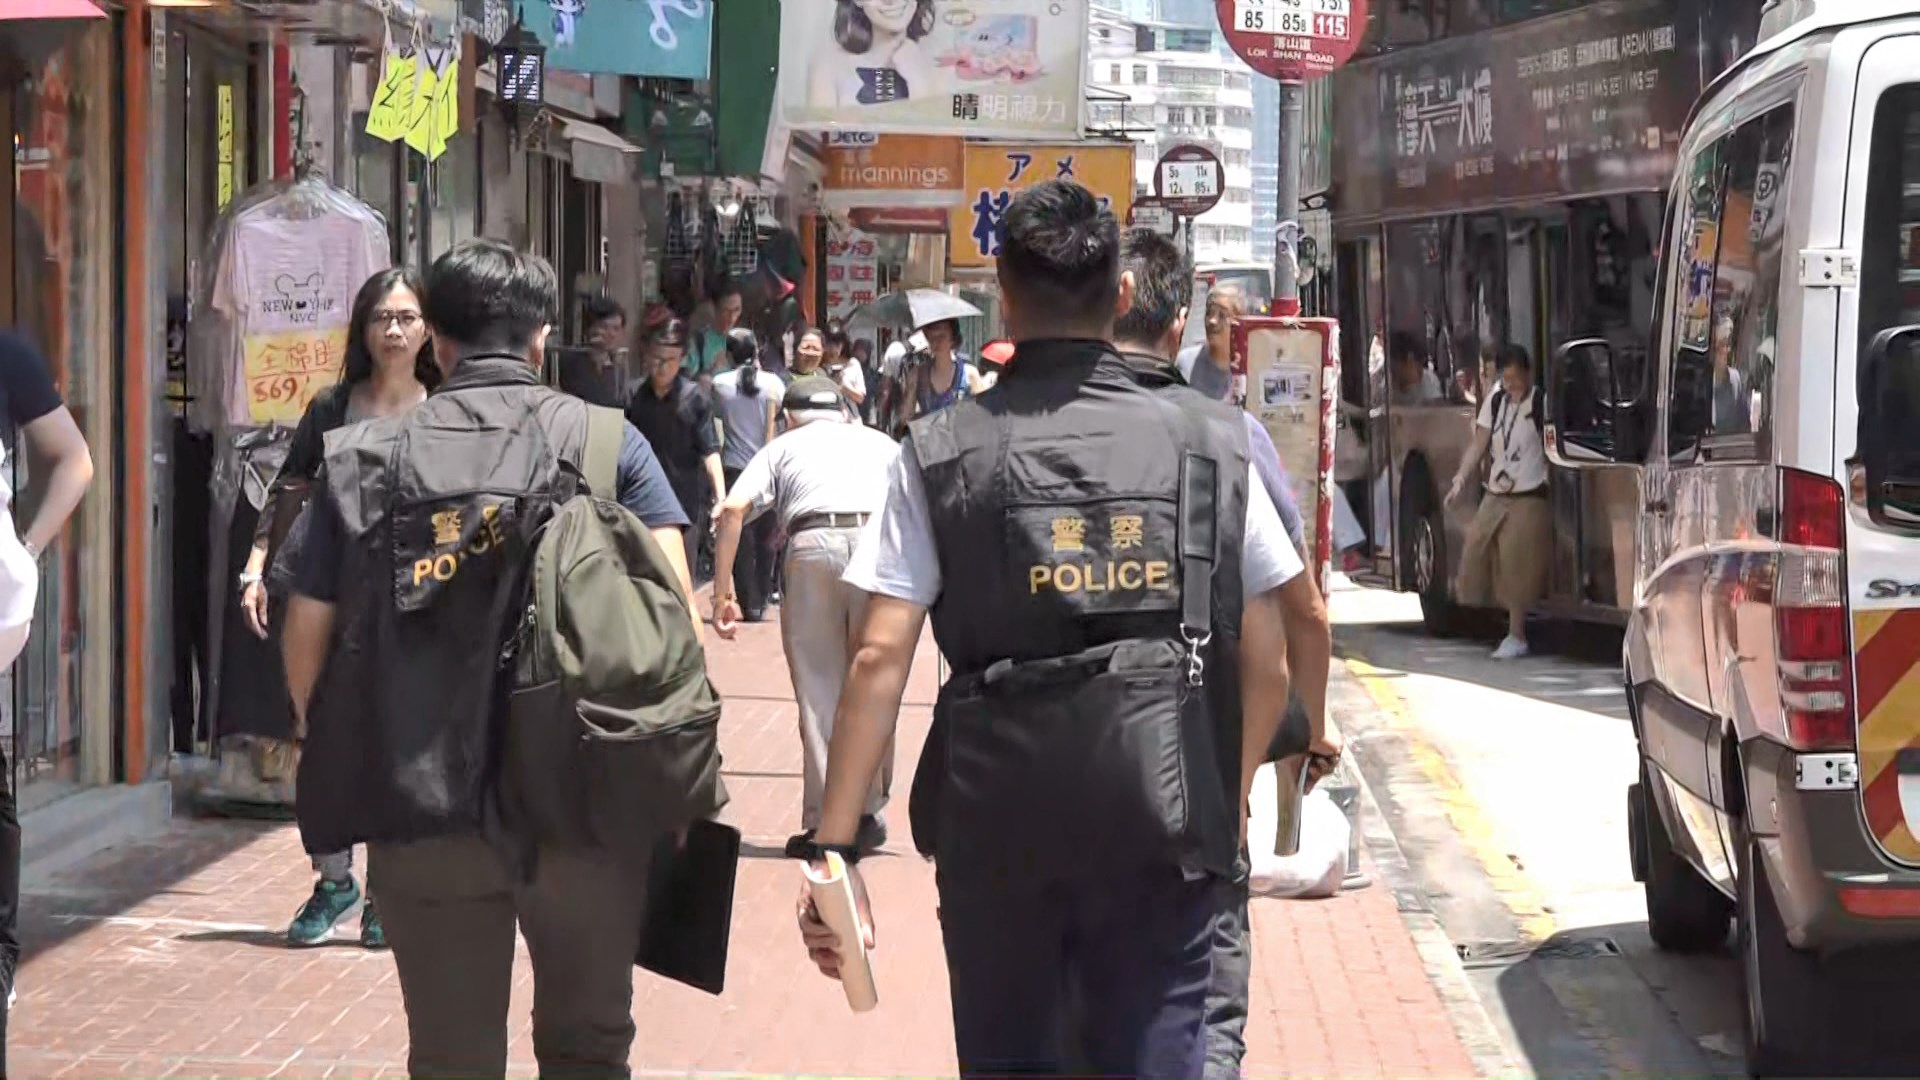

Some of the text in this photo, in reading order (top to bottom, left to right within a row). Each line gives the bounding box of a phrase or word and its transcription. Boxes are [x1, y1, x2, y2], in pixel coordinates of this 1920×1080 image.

[1245, 11, 1345, 36] 85 85B 115
[1247, 48, 1335, 64] LOK SHAN ROAD
[840, 162, 950, 187] mannings
[262, 299, 294, 313] NEW
[1050, 515, 1144, 552] 警察
[1029, 559, 1171, 595] POLICE
